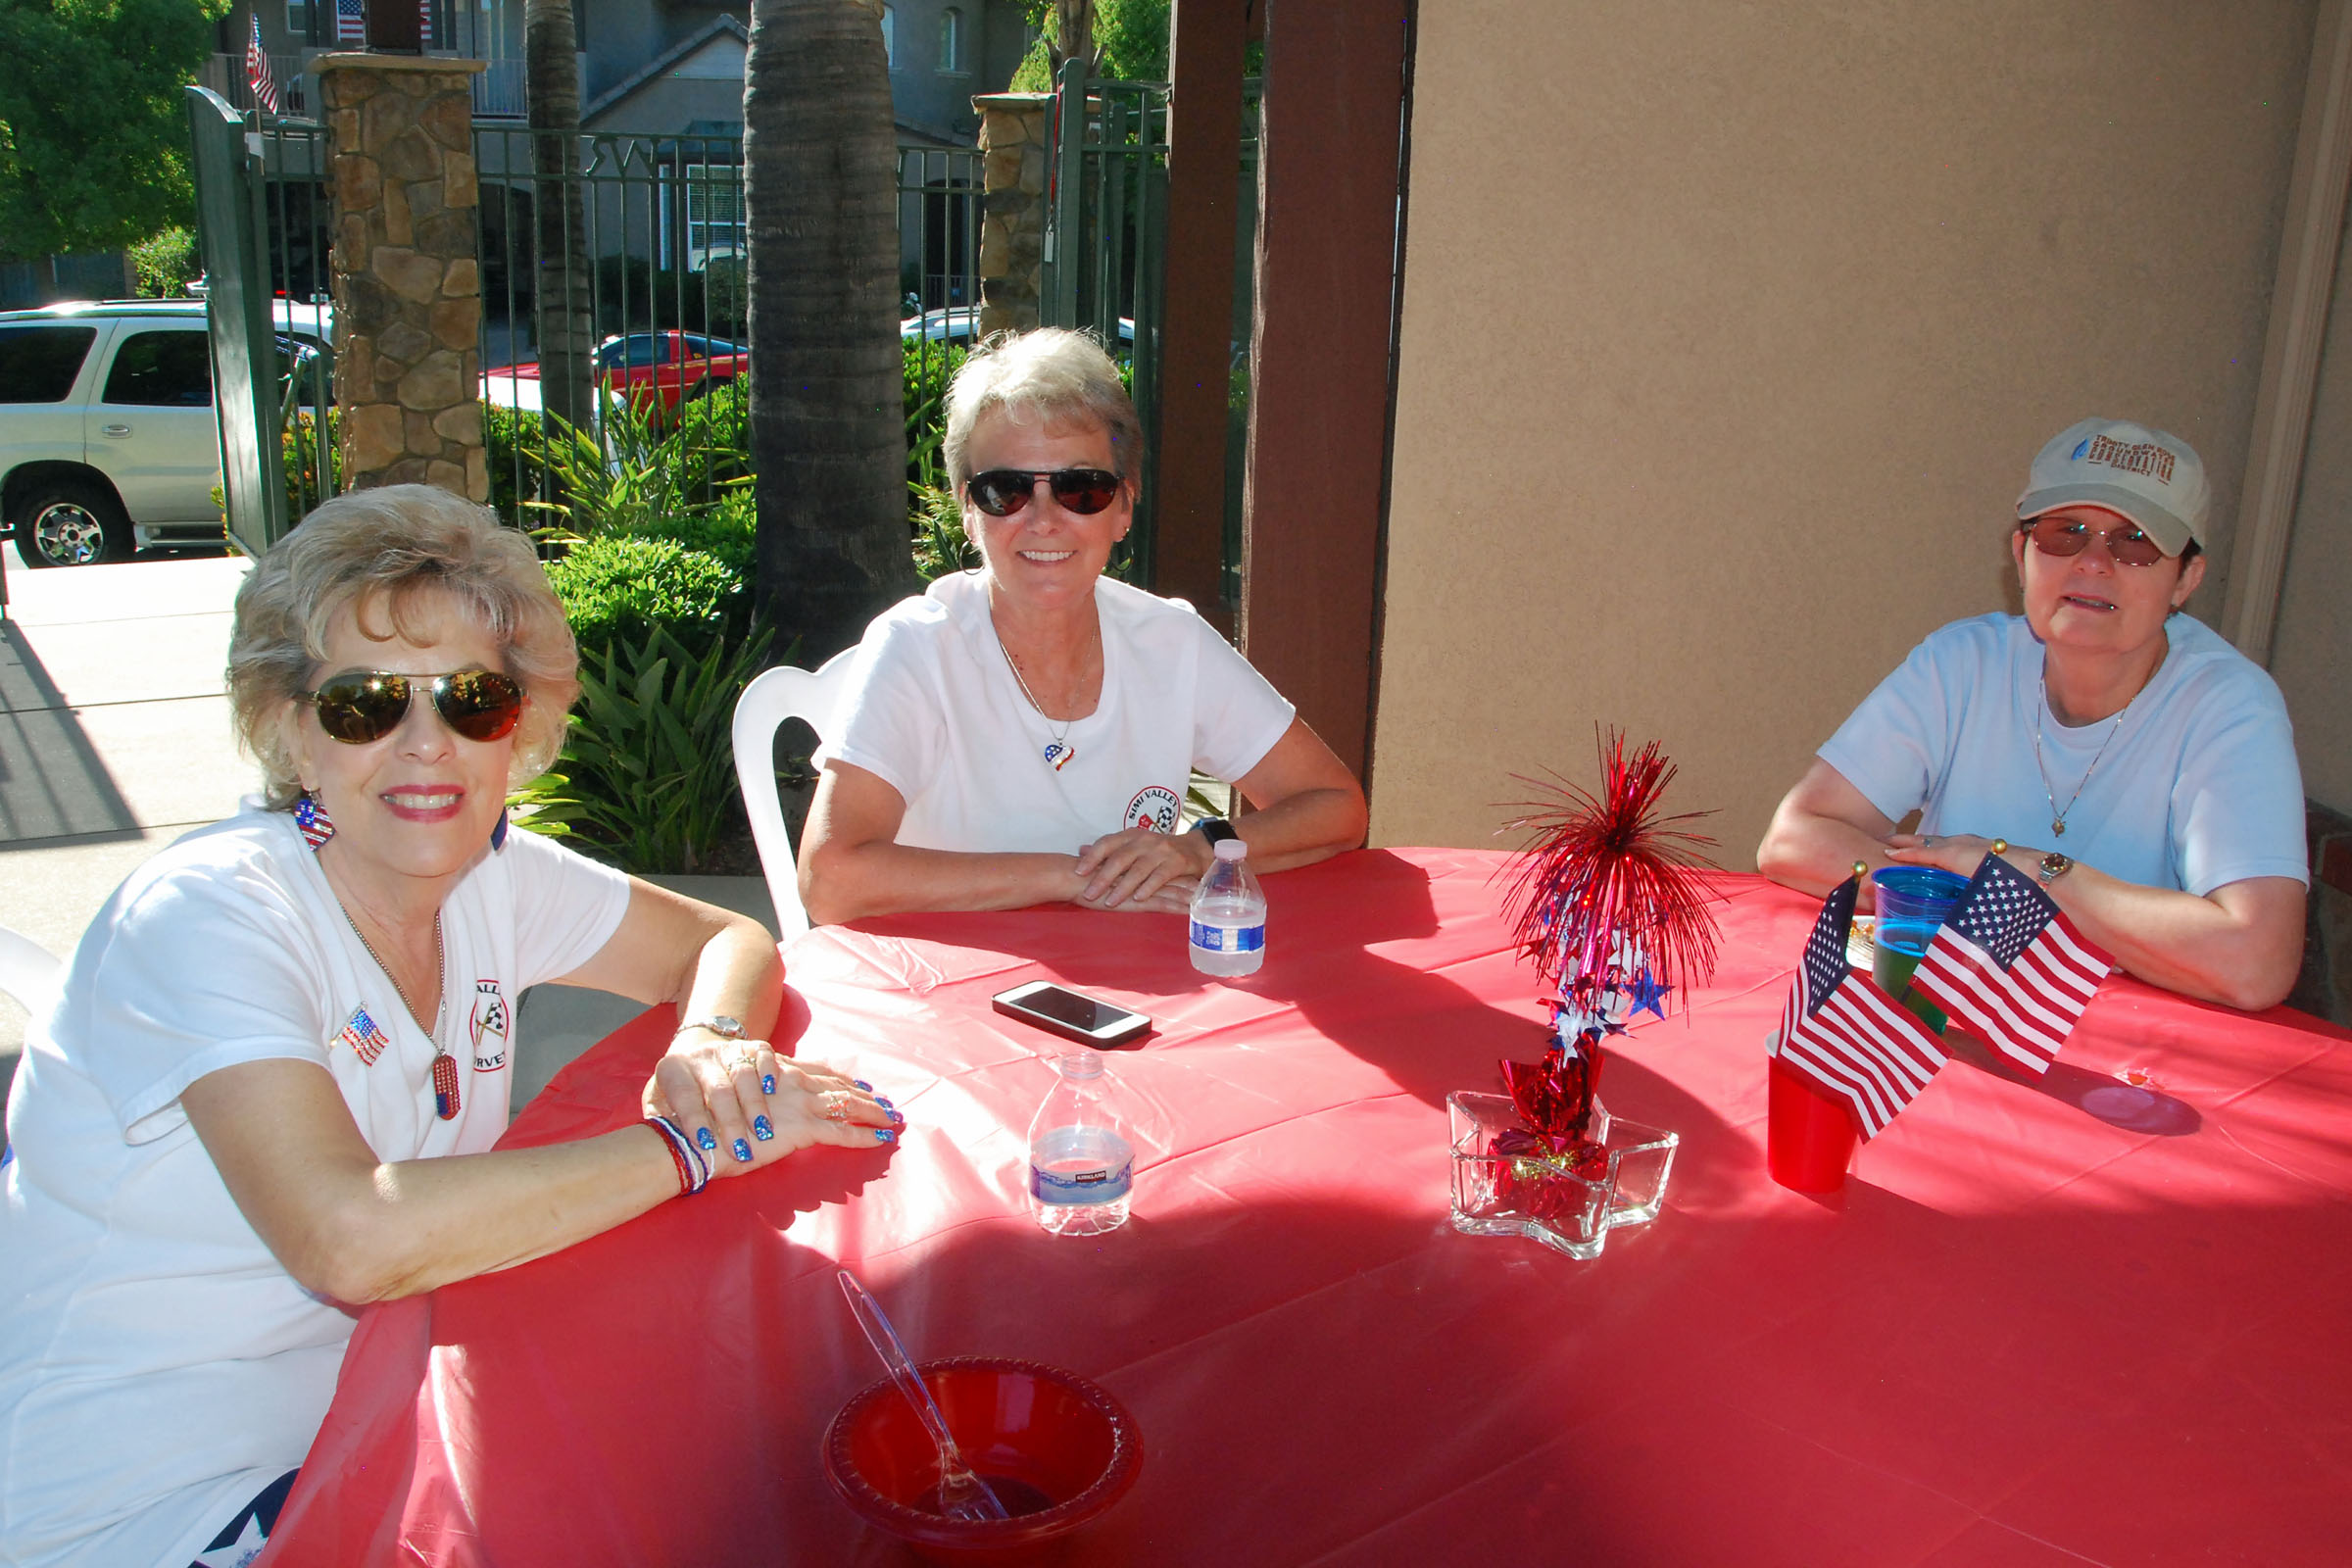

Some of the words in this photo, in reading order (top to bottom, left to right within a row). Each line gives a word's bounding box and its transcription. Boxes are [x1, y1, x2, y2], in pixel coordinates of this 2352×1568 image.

[2111, 462, 2151, 477] DISTRICT
[1128, 796, 1145, 820] SIMI
[1144, 789, 1178, 808] VALLEY
[474, 1051, 506, 1067] RVE
